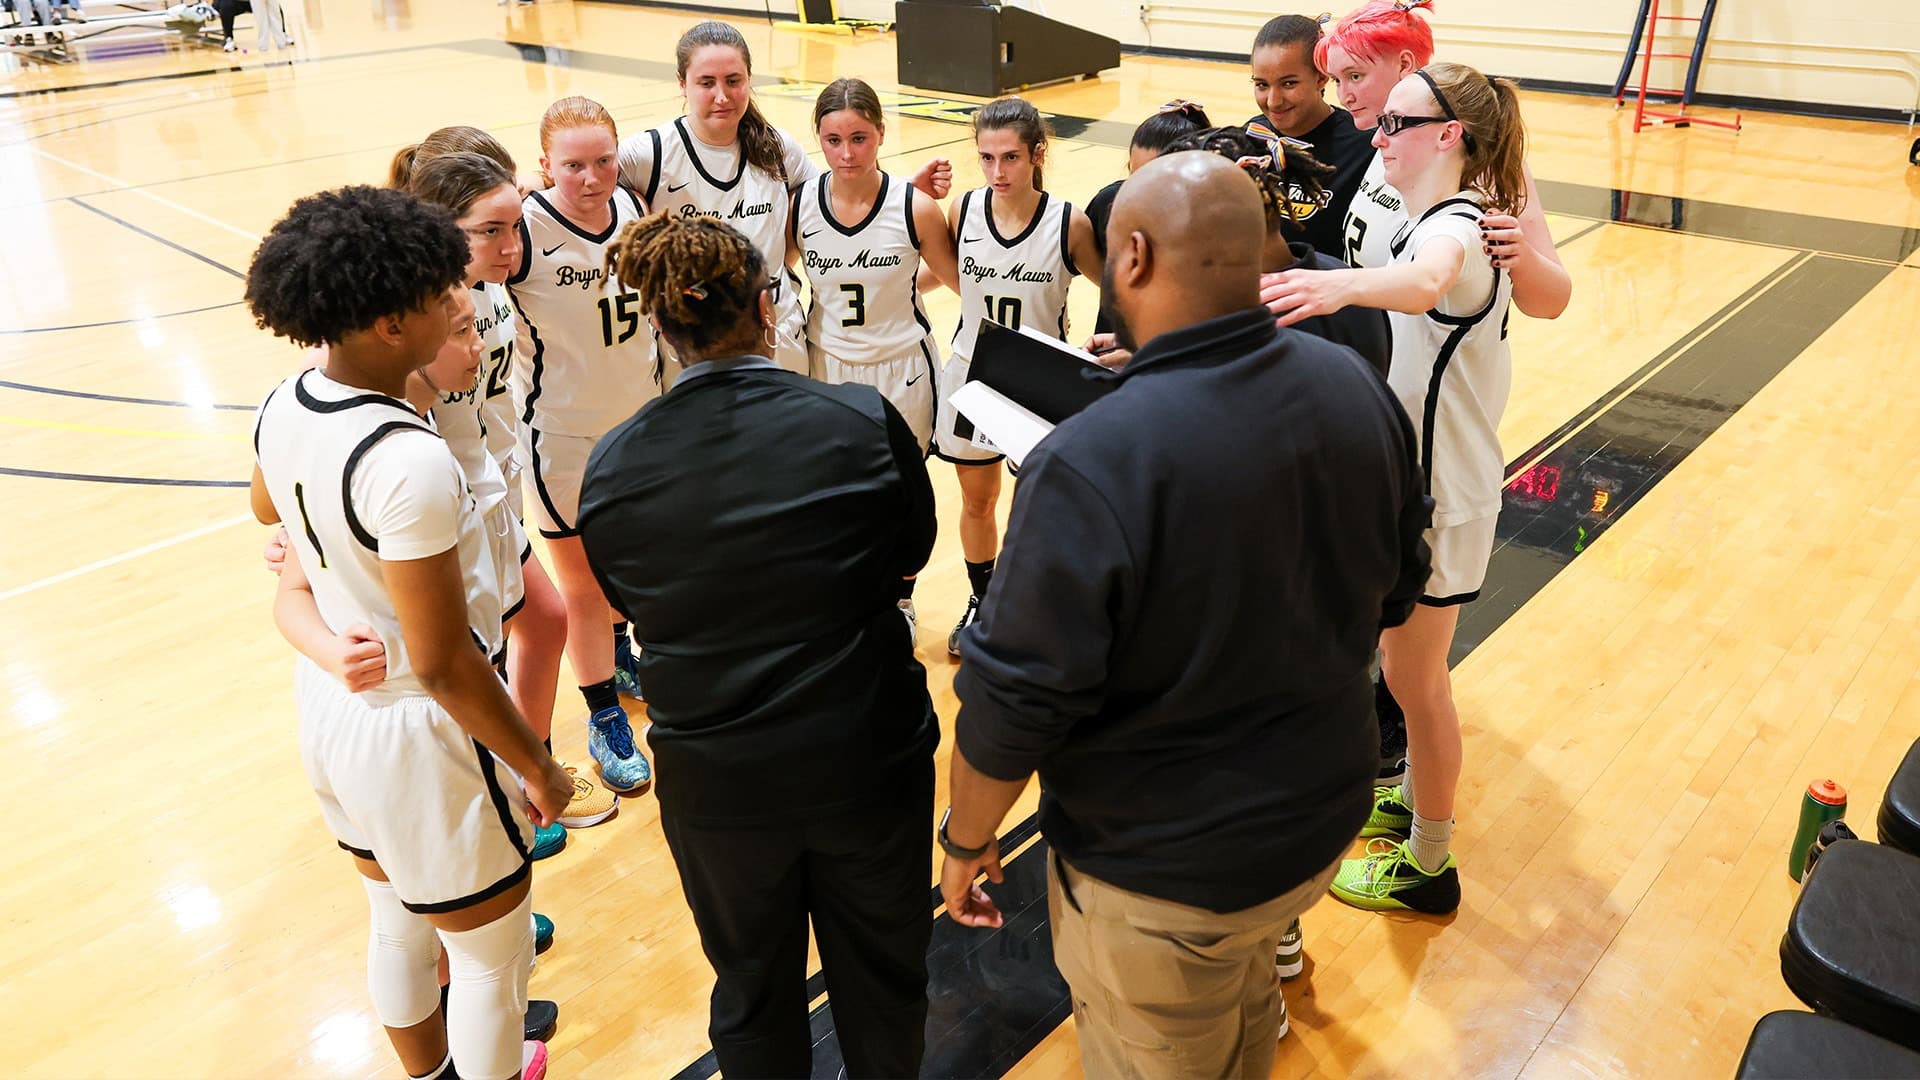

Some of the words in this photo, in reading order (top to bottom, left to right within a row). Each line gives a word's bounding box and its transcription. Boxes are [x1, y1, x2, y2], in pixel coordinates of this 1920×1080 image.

[680, 204, 722, 219] Brn
[727, 199, 773, 219] Mawr
[556, 265, 602, 290] Bryn
[806, 250, 842, 275] Bryn
[848, 249, 901, 269] Mawr
[962, 256, 997, 283] Bryn
[1002, 262, 1054, 283] Mawr
[598, 292, 639, 347] 15
[840, 283, 865, 327] 3
[984, 295, 1022, 331] 10
[486, 340, 513, 400] 21
[295, 481, 327, 569] 1
